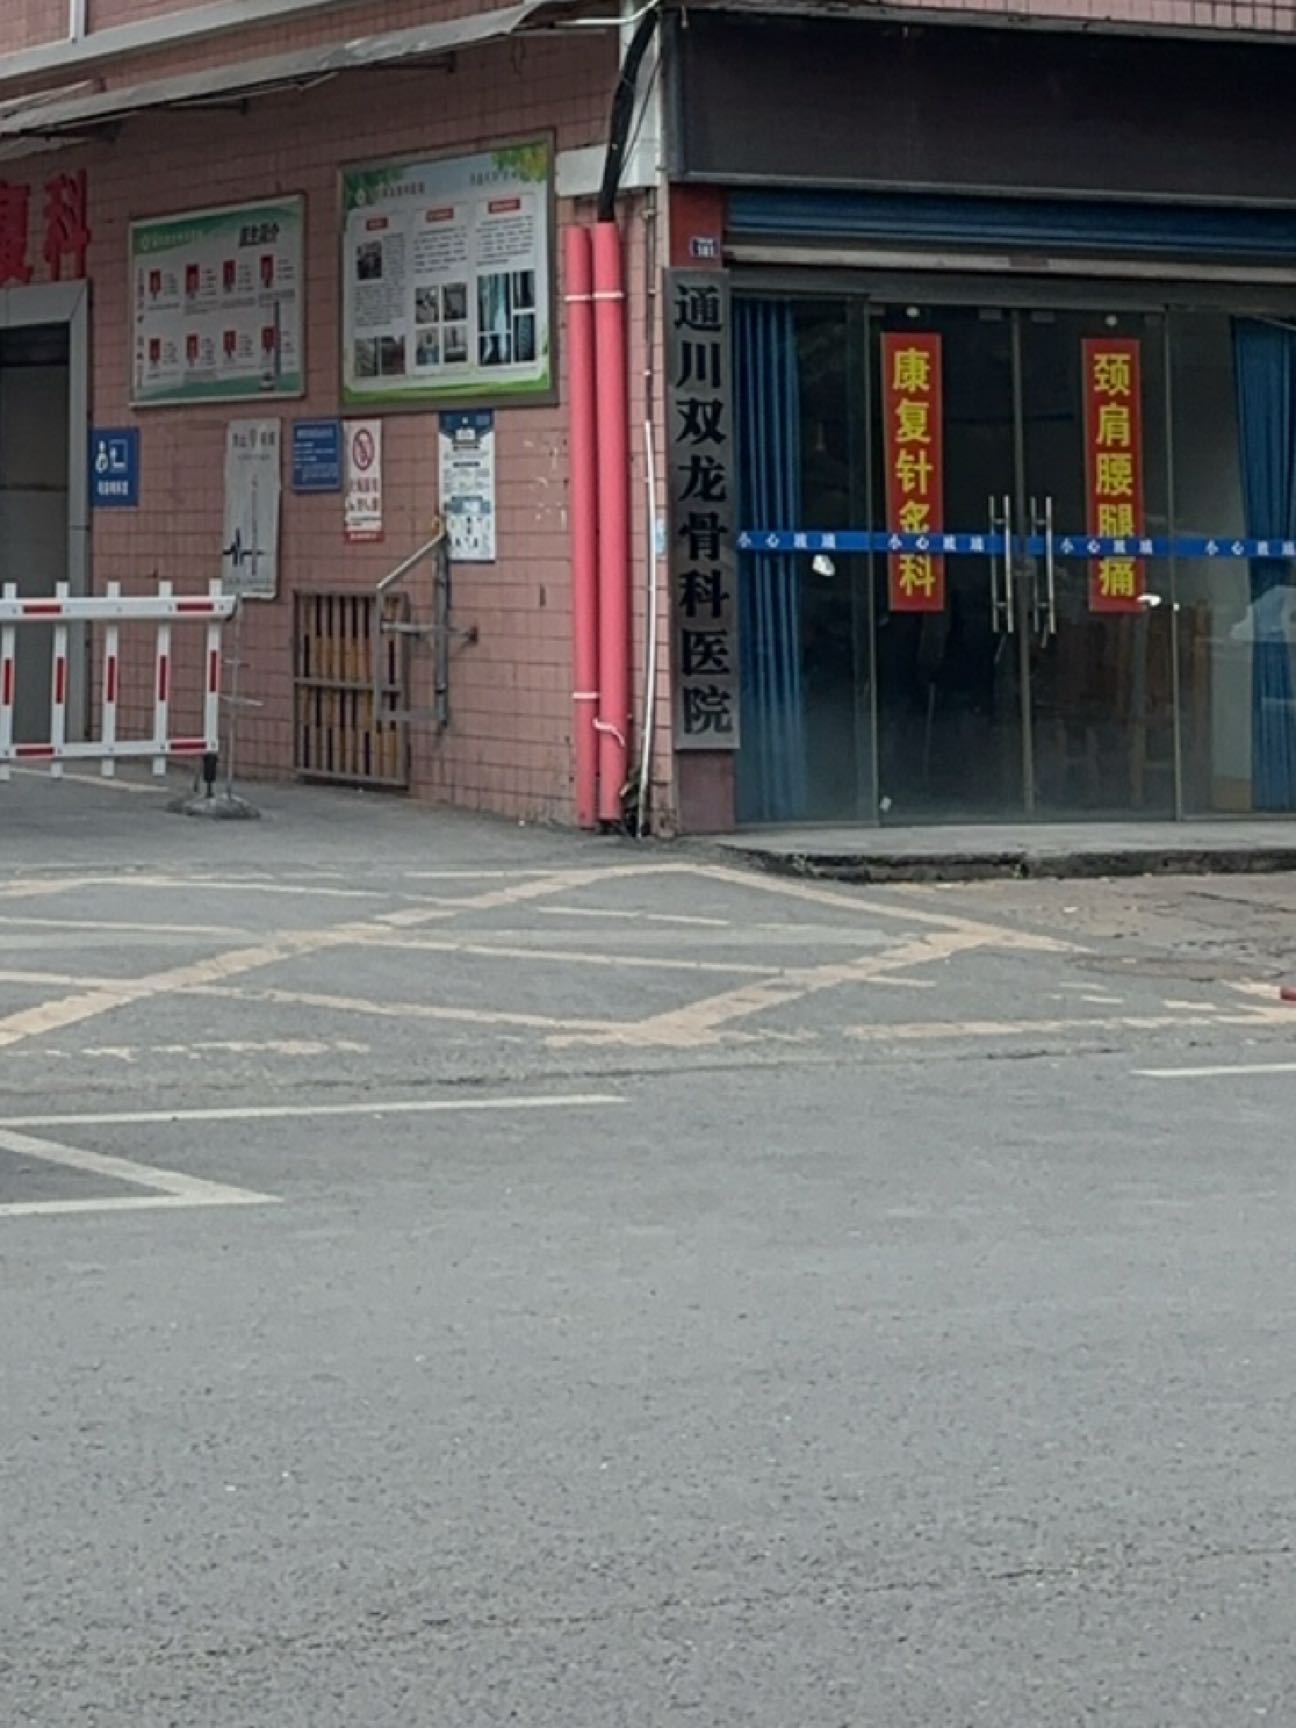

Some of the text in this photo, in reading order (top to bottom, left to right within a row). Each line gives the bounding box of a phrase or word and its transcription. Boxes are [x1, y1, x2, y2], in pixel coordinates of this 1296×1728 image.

[673, 284, 733, 735] 通川双龙骨科医院
[1092, 352, 1138, 597] 颈肩腰腿痛
